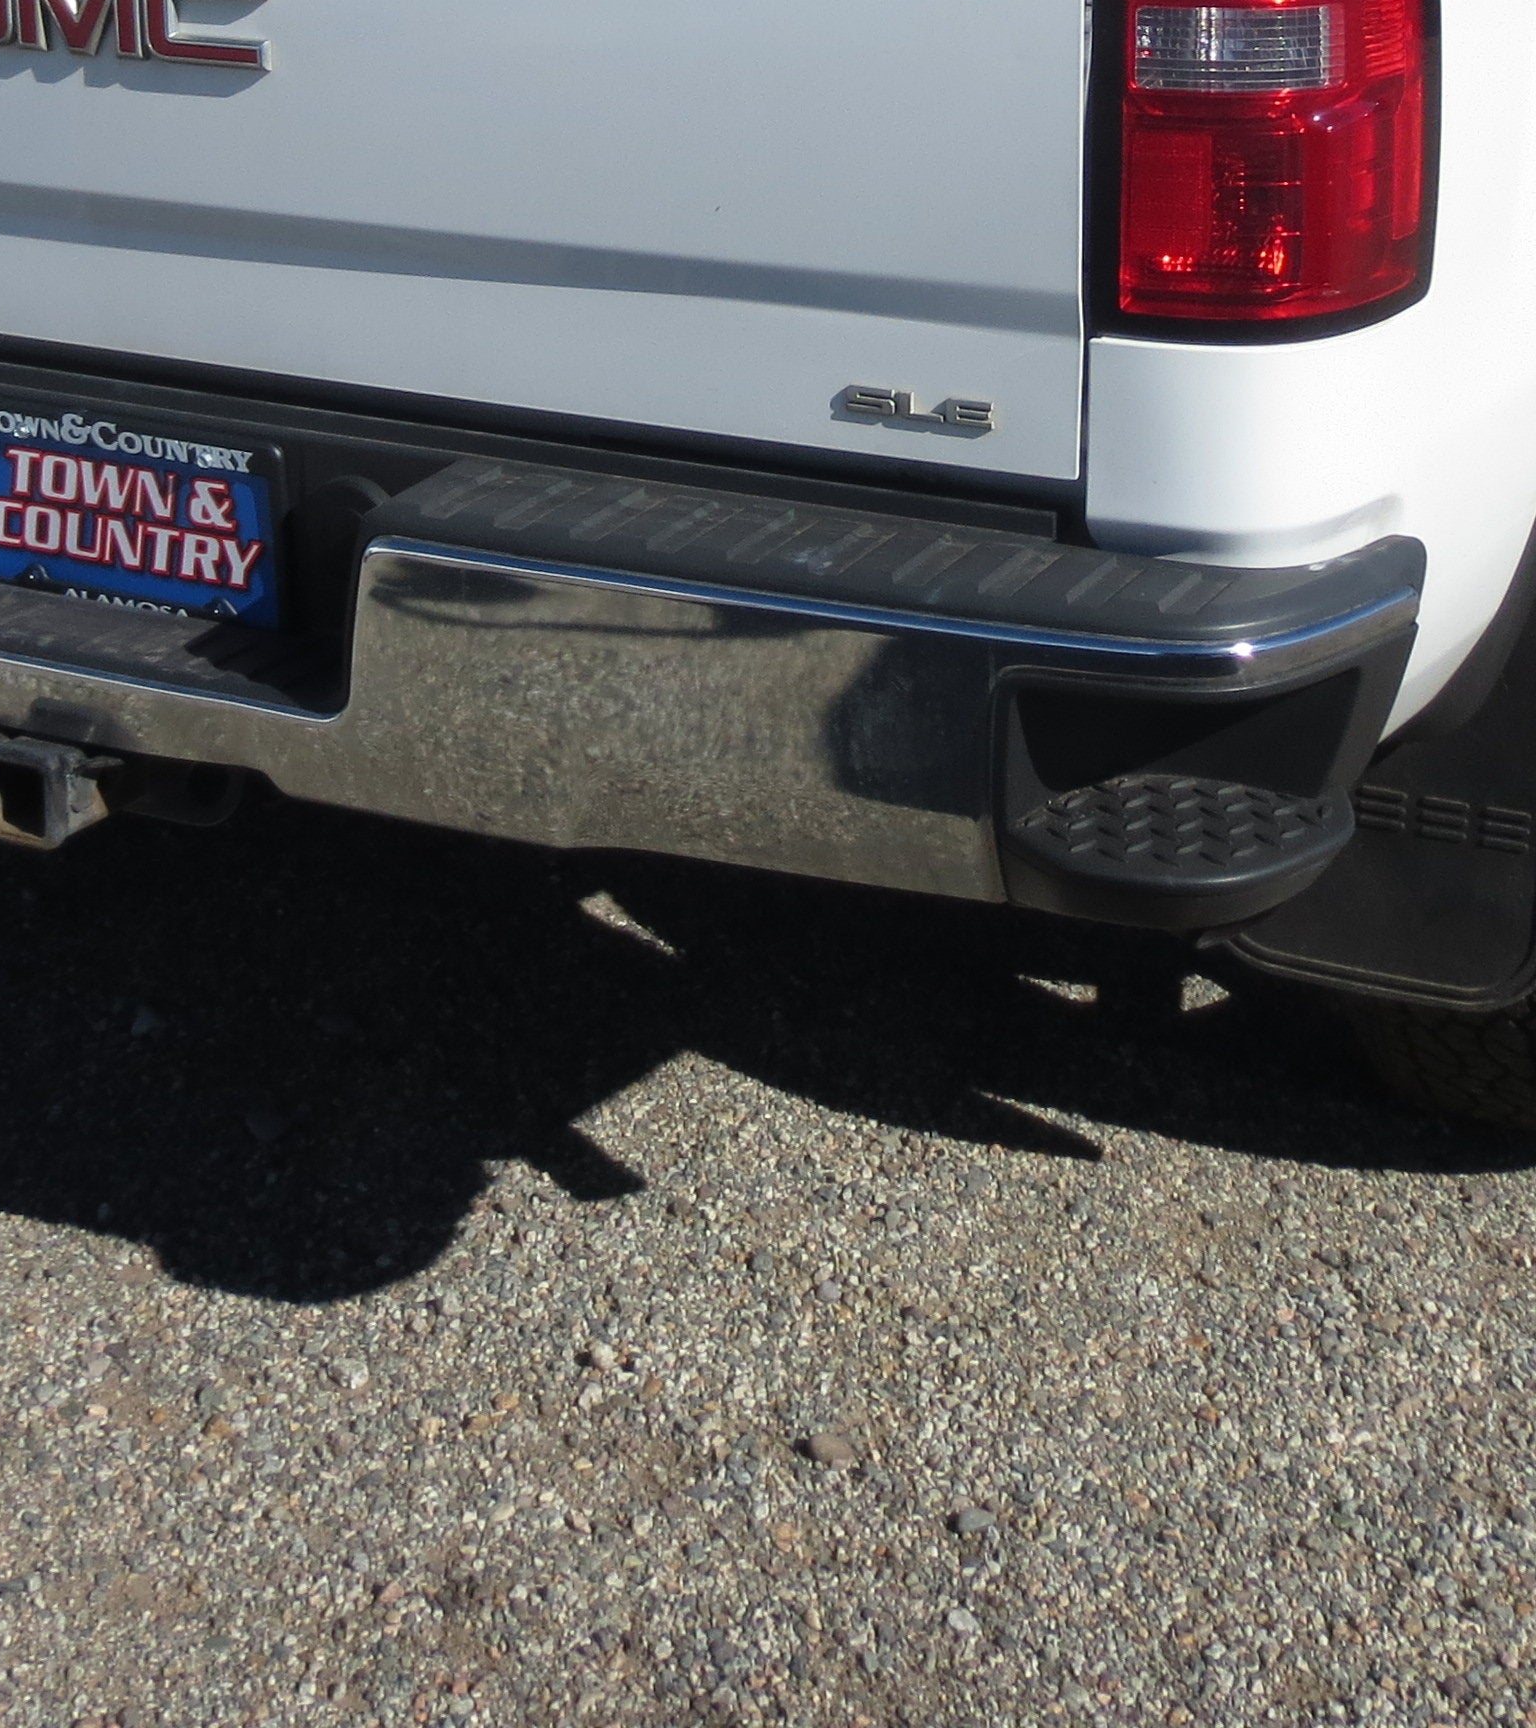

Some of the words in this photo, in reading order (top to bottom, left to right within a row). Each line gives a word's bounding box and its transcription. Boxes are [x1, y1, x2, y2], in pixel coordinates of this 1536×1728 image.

[844, 384, 996, 430] SLE
[6, 447, 177, 521] TOWN
[188, 476, 238, 531] &
